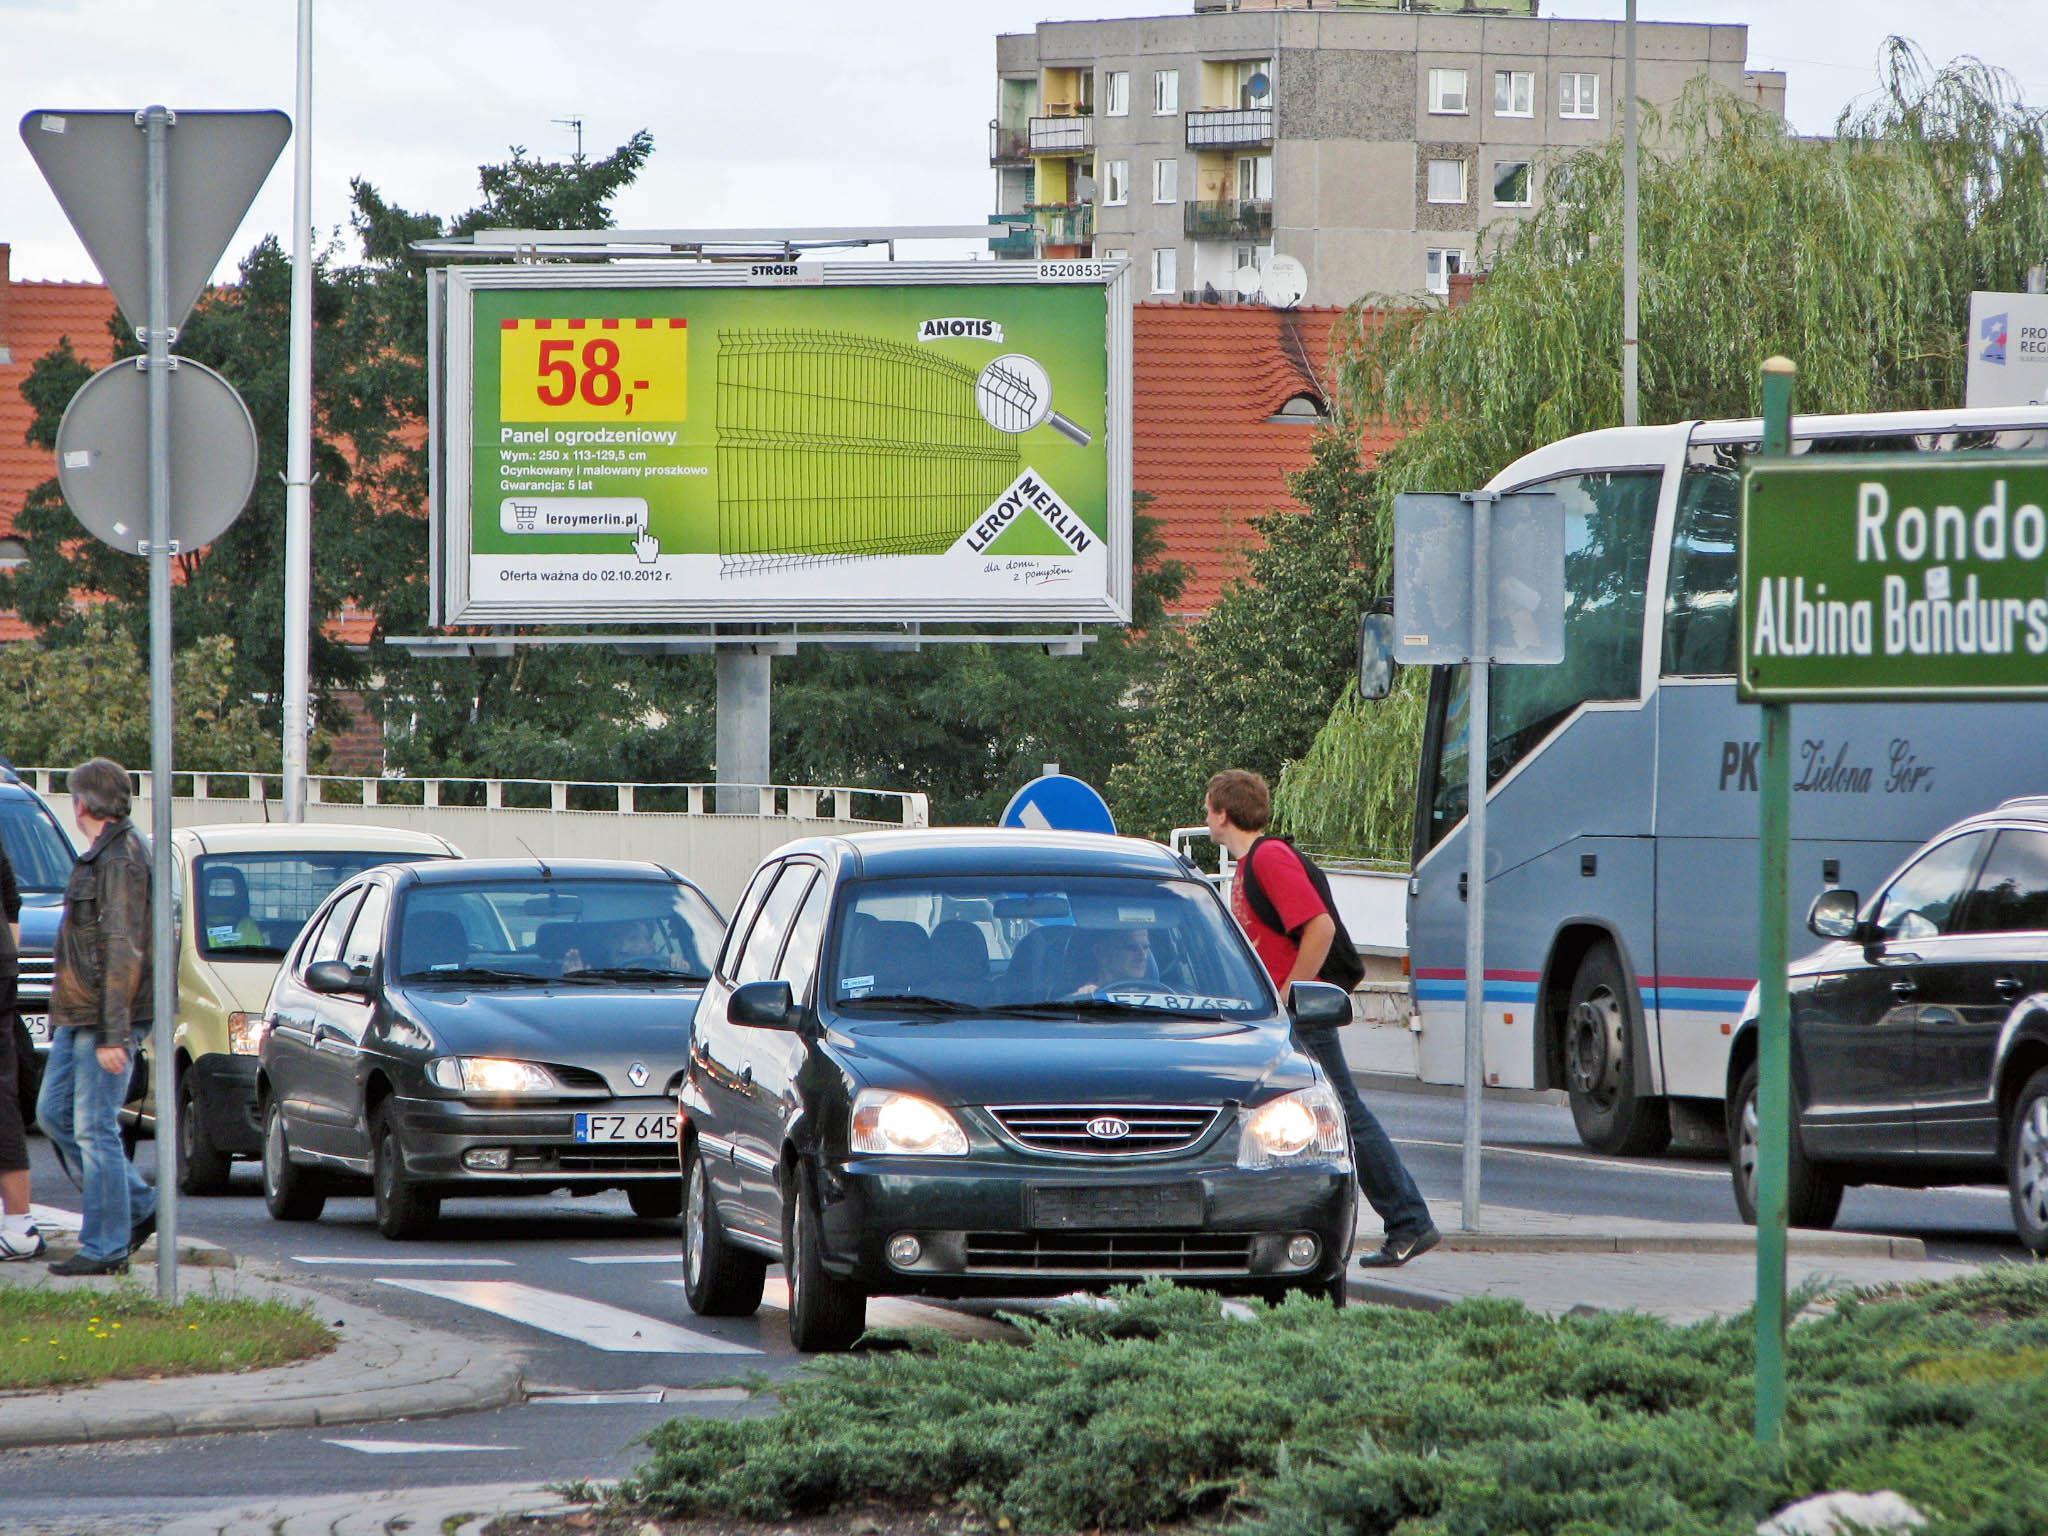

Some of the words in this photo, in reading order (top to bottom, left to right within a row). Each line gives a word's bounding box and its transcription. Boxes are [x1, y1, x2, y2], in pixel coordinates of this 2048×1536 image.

[751, 263, 798, 276] STRÖER
[1040, 264, 1101, 277] 8520853
[924, 320, 993, 336] ANOTIS
[500, 427, 549, 443] Panel
[554, 427, 678, 445] ogrodzeniowy
[500, 450, 537, 462] Wym.:
[538, 450, 560, 461] 250
[562, 452, 569, 461] x
[573, 450, 626, 462] 113-129,5
[628, 452, 646, 461] cm
[500, 465, 573, 477] Ocynkowany
[576, 465, 580, 475] i
[582, 465, 643, 477] malowany
[645, 465, 708, 477] proszkowo
[500, 480, 565, 491] Gwarancja:
[567, 480, 575, 490] 5
[577, 480, 593, 490] lat
[546, 513, 638, 527] leroymerlin.pl
[966, 490, 1024, 552] LEROY
[1018, 476, 1092, 553] MERLIN
[1856, 479, 2046, 562] Rondo
[983, 562, 1001, 573] dla
[500, 569, 537, 581] Oferta
[540, 569, 579, 581] ważna
[583, 570, 597, 581] do
[600, 570, 662, 582] 02.10.2012
[665, 572, 673, 581] r.
[1753, 576, 1872, 656] Albina
[1719, 741, 1761, 791] PK
[25, 1016, 46, 1035] 25
[591, 1116, 625, 1139] FZ
[635, 1116, 678, 1139] 645
[1093, 1121, 1123, 1135] KIA
